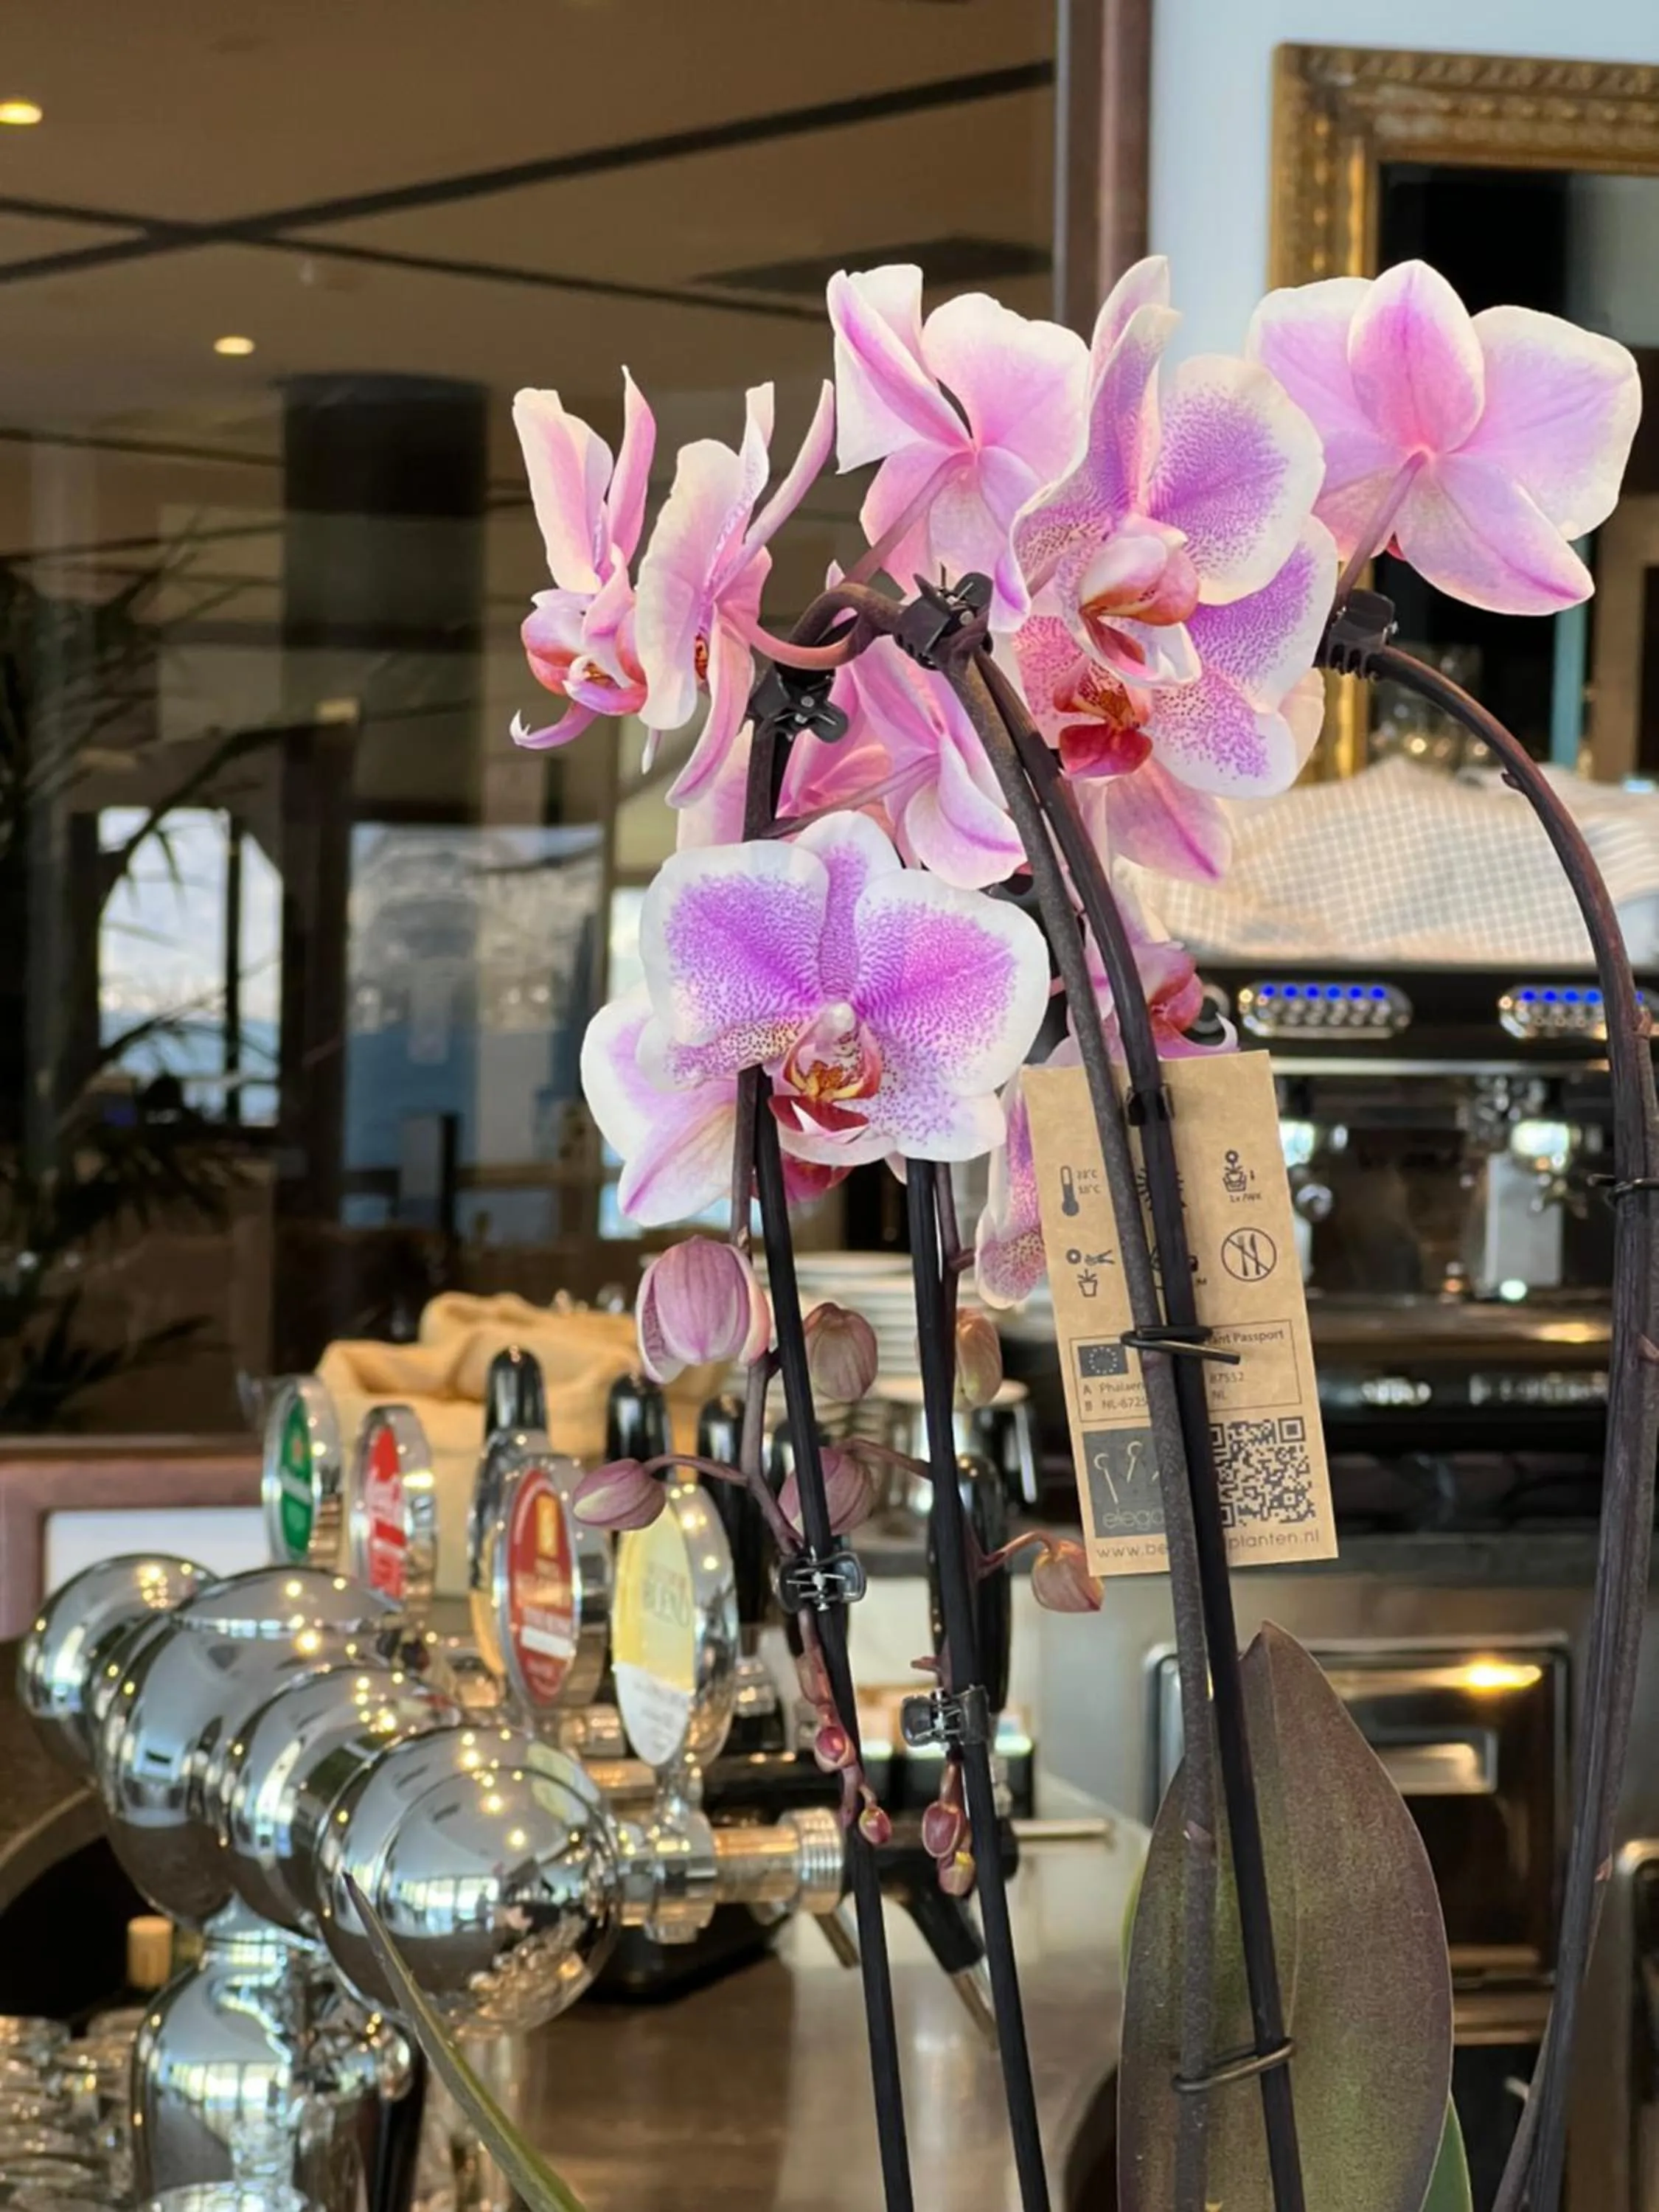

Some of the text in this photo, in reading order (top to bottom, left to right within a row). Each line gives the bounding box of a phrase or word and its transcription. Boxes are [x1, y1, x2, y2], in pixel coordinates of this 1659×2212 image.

[1233, 1329, 1284, 1344] Passport
[1083, 1384, 1092, 1395] A
[1103, 1509, 1164, 1531] elega
